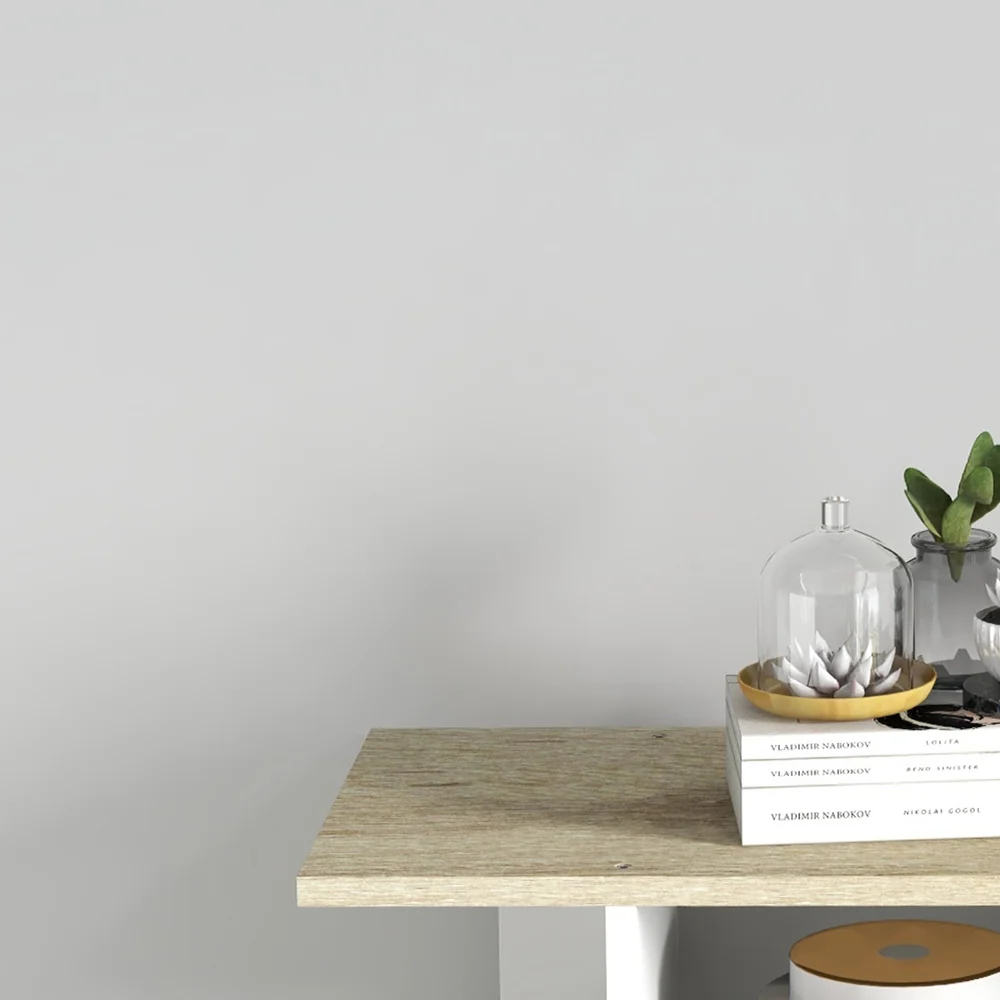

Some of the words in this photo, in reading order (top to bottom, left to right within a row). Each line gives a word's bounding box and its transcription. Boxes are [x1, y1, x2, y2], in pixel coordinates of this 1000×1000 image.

[771, 743, 820, 751] VLADIMIR
[822, 741, 871, 750] NABOKOV
[771, 769, 820, 777] VLADIMIR
[822, 767, 871, 776] NABOKOV
[771, 812, 820, 821] VLADIMIR
[822, 810, 871, 819] NABOKOV
